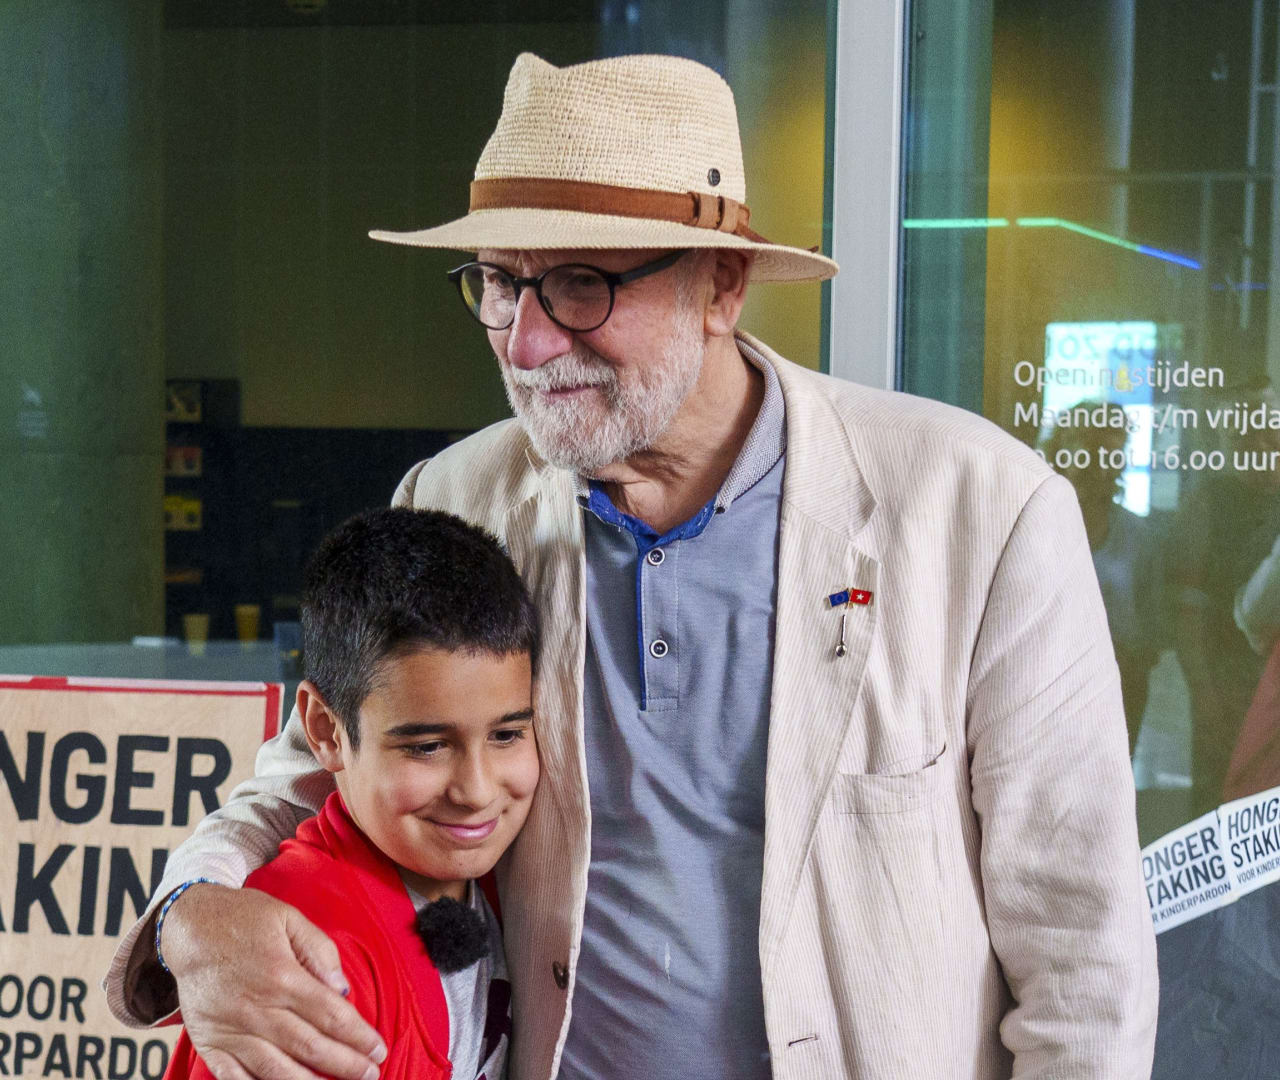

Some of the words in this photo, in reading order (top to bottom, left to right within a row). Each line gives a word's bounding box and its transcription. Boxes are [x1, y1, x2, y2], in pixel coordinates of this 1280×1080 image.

[1014, 361, 1225, 394] Openingstijden
[1014, 402, 1142, 433] Maandag
[1151, 403, 1198, 434] t/m
[1234, 450, 1280, 471] uur
[1142, 827, 1220, 881] ONGER
[1146, 855, 1226, 909] TAKING
[1236, 867, 1257, 884] VOOR
[1160, 882, 1231, 919] KINDERPARDON
